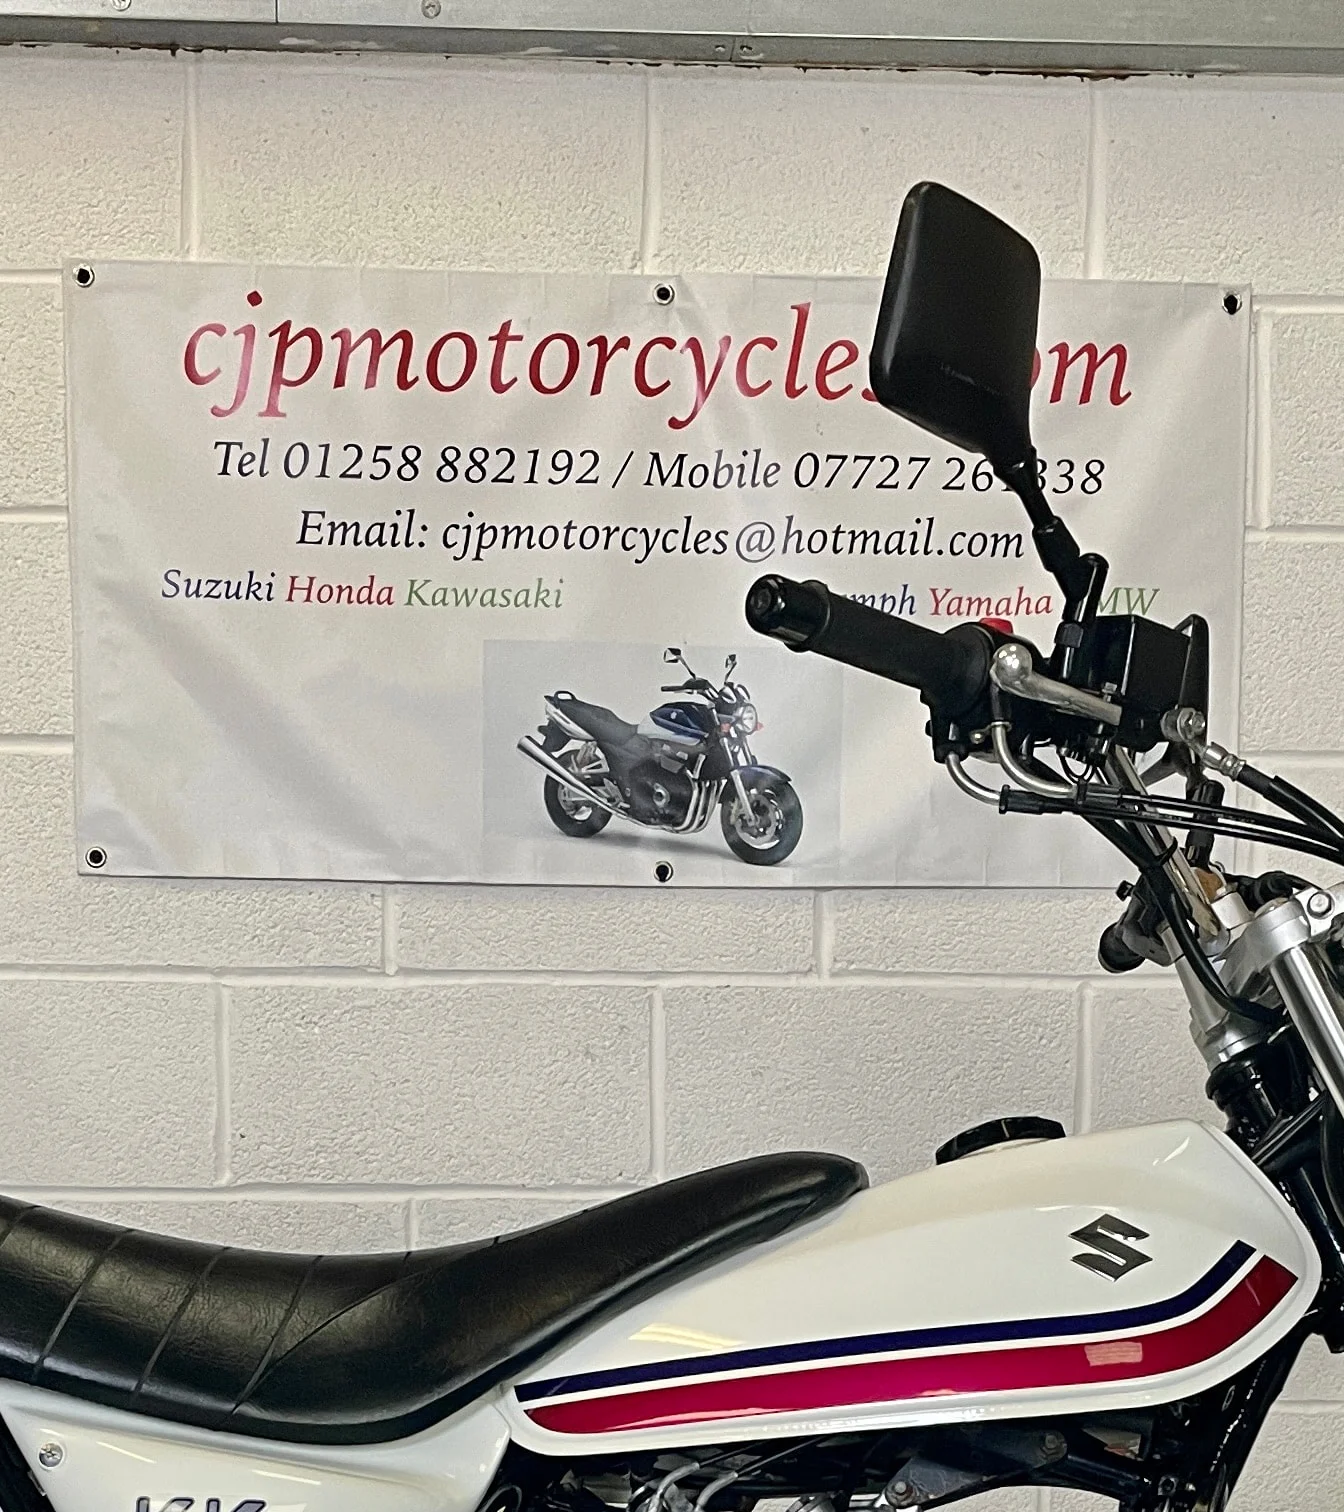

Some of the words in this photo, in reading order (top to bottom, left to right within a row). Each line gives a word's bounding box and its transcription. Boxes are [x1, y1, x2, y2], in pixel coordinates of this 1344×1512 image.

[184, 290, 1132, 430] cjpmotorcyclem
[214, 438, 269, 477] Tel
[284, 442, 421, 481] 01258
[436, 446, 599, 485] 882192
[612, 451, 634, 488] /
[643, 448, 781, 489] Mobile
[794, 452, 931, 490] 07727
[296, 509, 428, 548] Email:
[443, 512, 1025, 564] cjpmotorcycles@hotmail.com
[162, 569, 275, 601] Suzuki
[285, 575, 395, 605] Honda
[404, 578, 563, 608] Kawasaki
[929, 586, 1050, 616] Yamaha
[1098, 587, 1160, 615] MW
